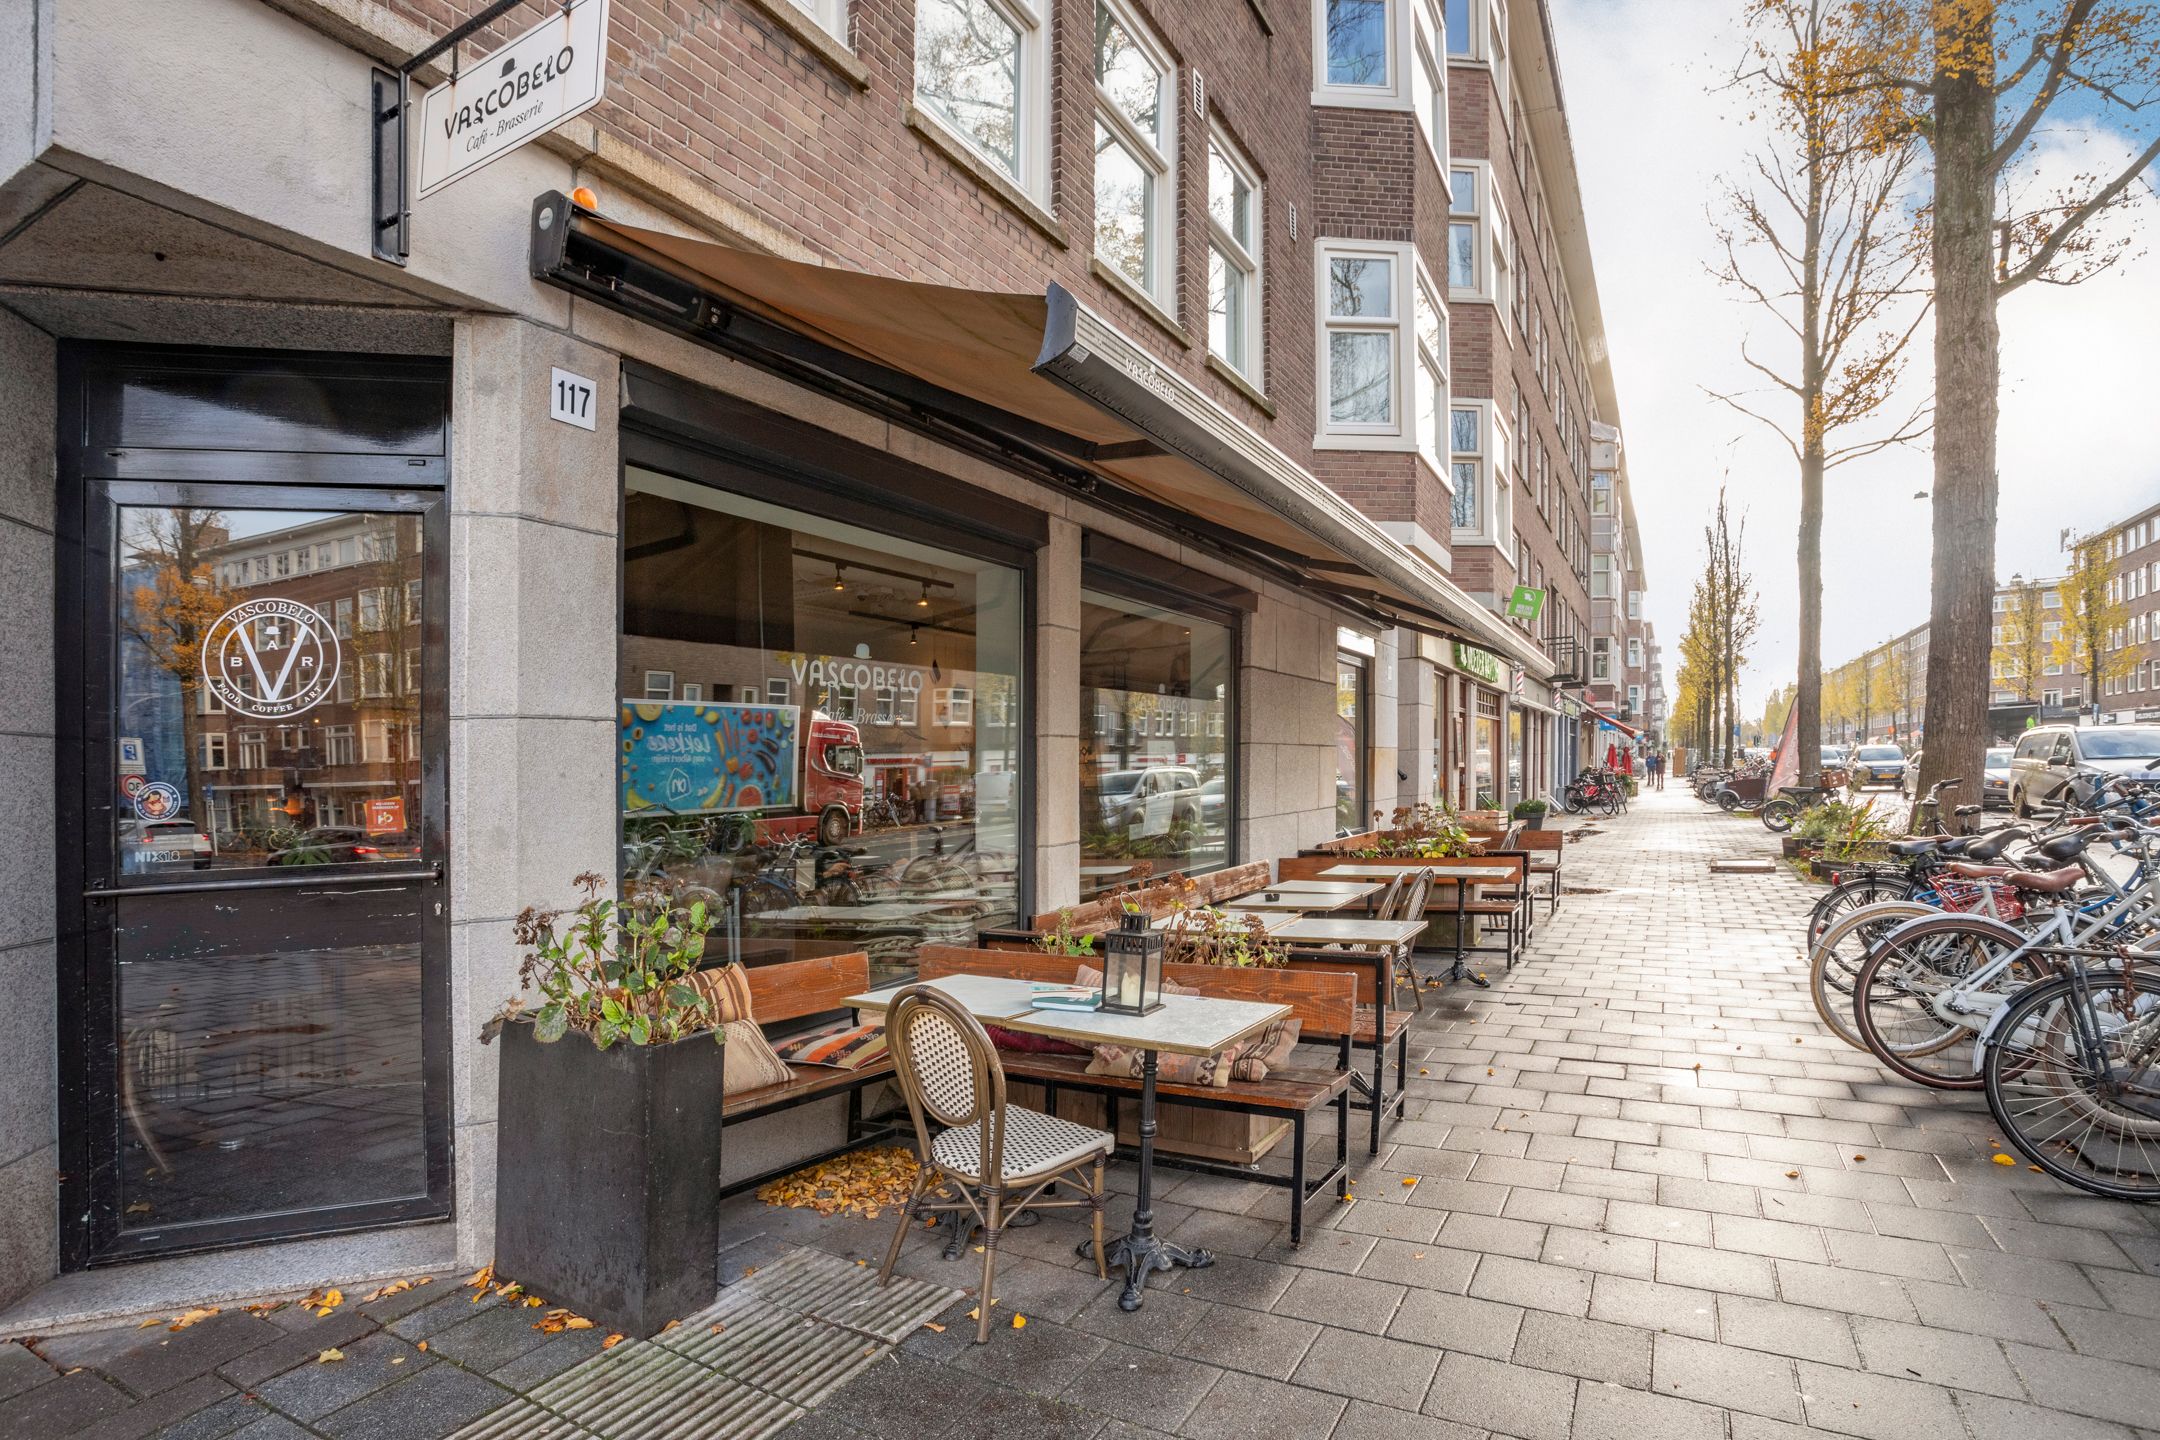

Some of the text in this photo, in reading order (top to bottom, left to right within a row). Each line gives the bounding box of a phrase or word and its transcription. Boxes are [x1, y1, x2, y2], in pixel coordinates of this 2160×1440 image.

[444, 45, 574, 140] VASCOBELO
[466, 128, 488, 153] Café
[496, 99, 544, 138] Brasserie
[1125, 357, 1175, 402] VASCOBELO
[558, 379, 591, 418] 117
[227, 601, 316, 625] VASCOBELO
[791, 658, 924, 694] VASCOBELO
[217, 682, 322, 713] FOOD COFFEE ART
[134, 850, 180, 863] NIX18
